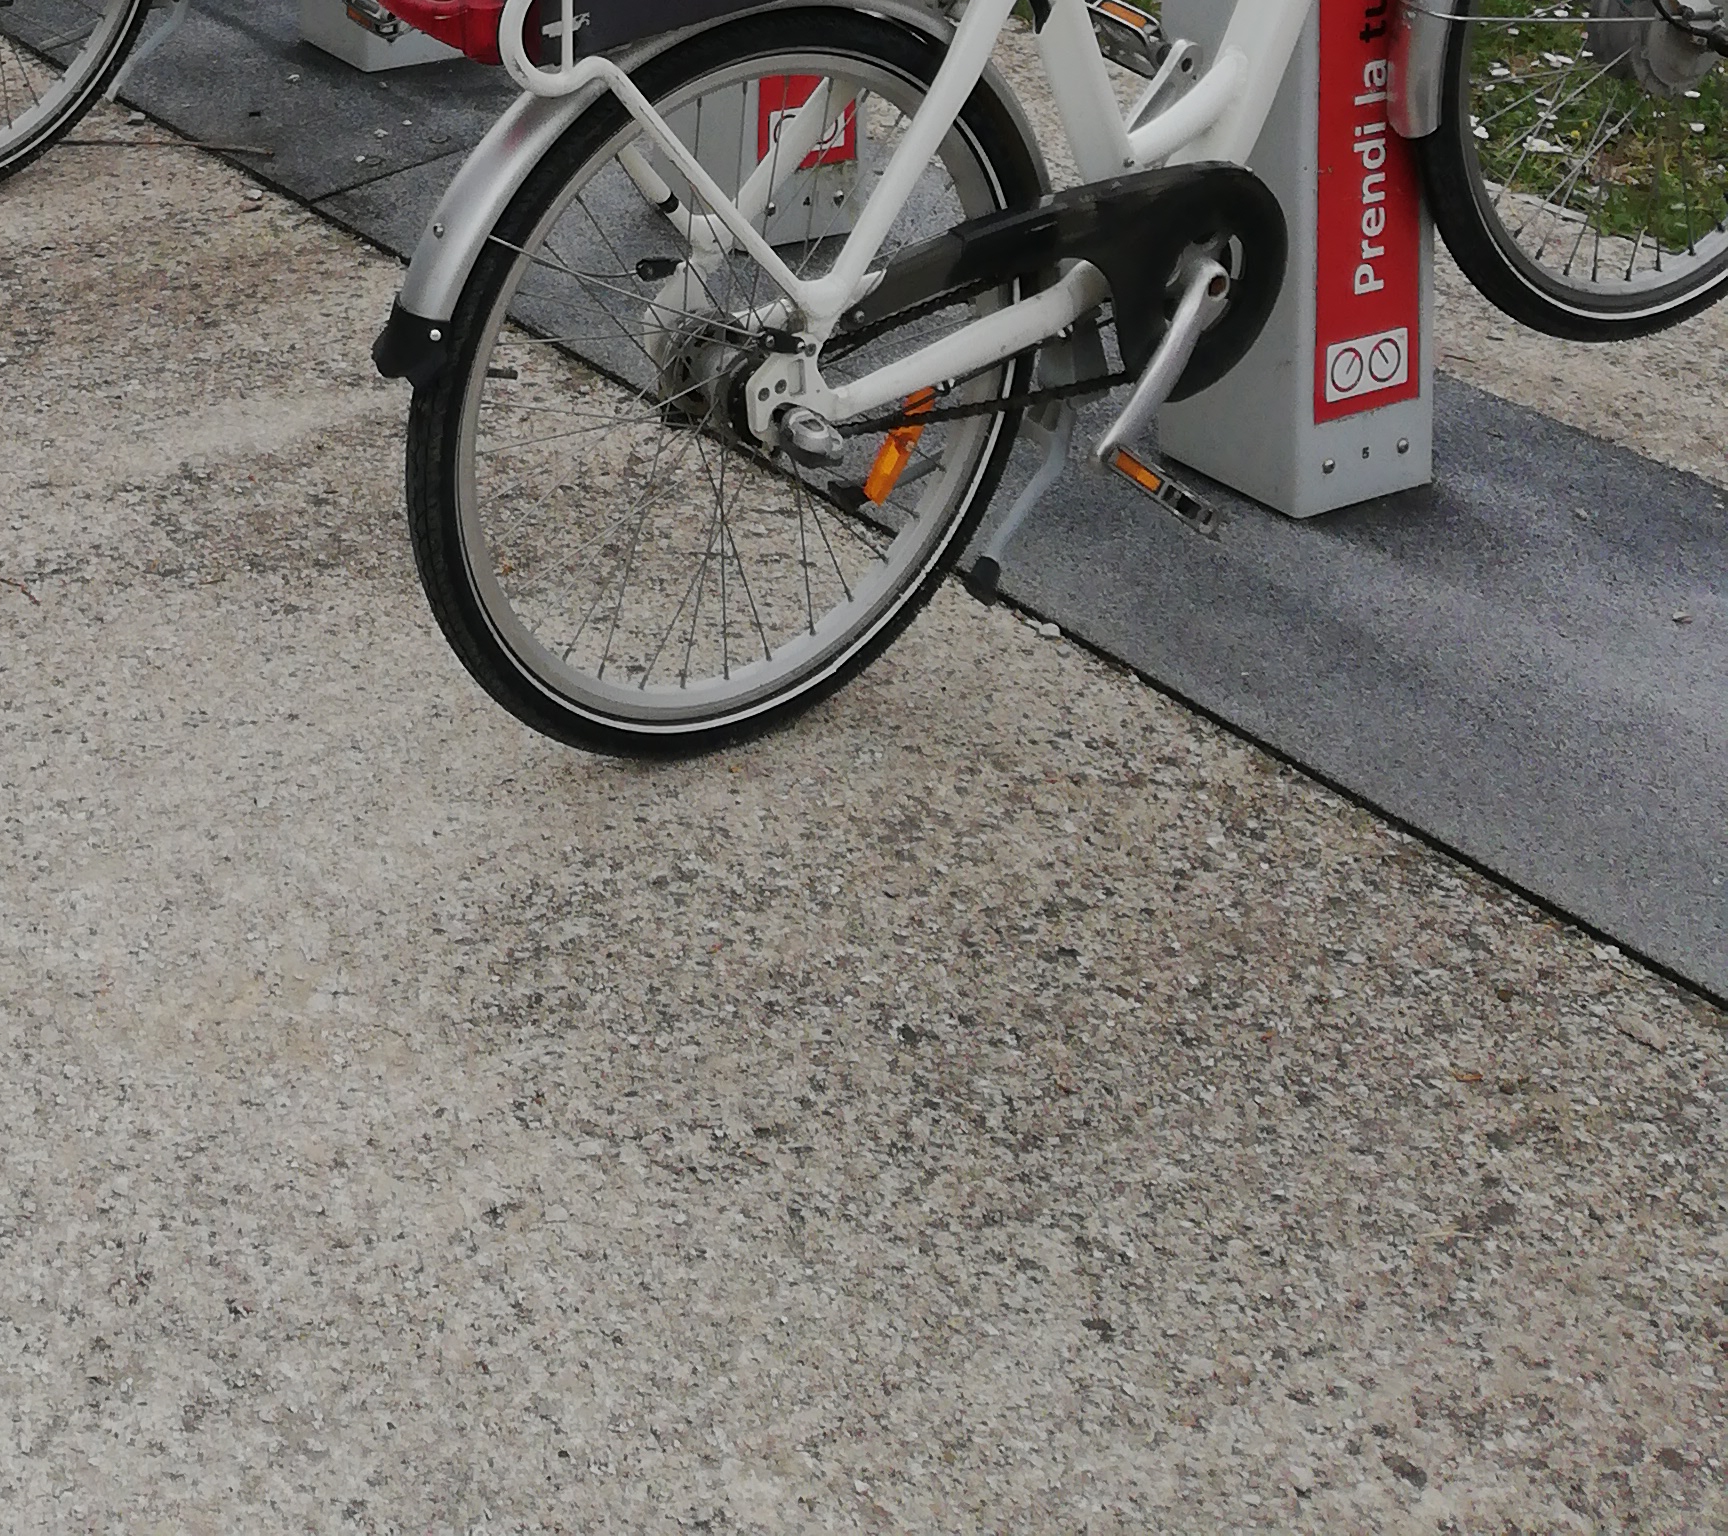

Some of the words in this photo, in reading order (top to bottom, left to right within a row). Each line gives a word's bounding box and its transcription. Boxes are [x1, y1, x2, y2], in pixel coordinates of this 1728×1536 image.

[1354, 58, 1388, 107] la
[1353, 121, 1387, 296] Prendi
[1361, 447, 1370, 460] 5
